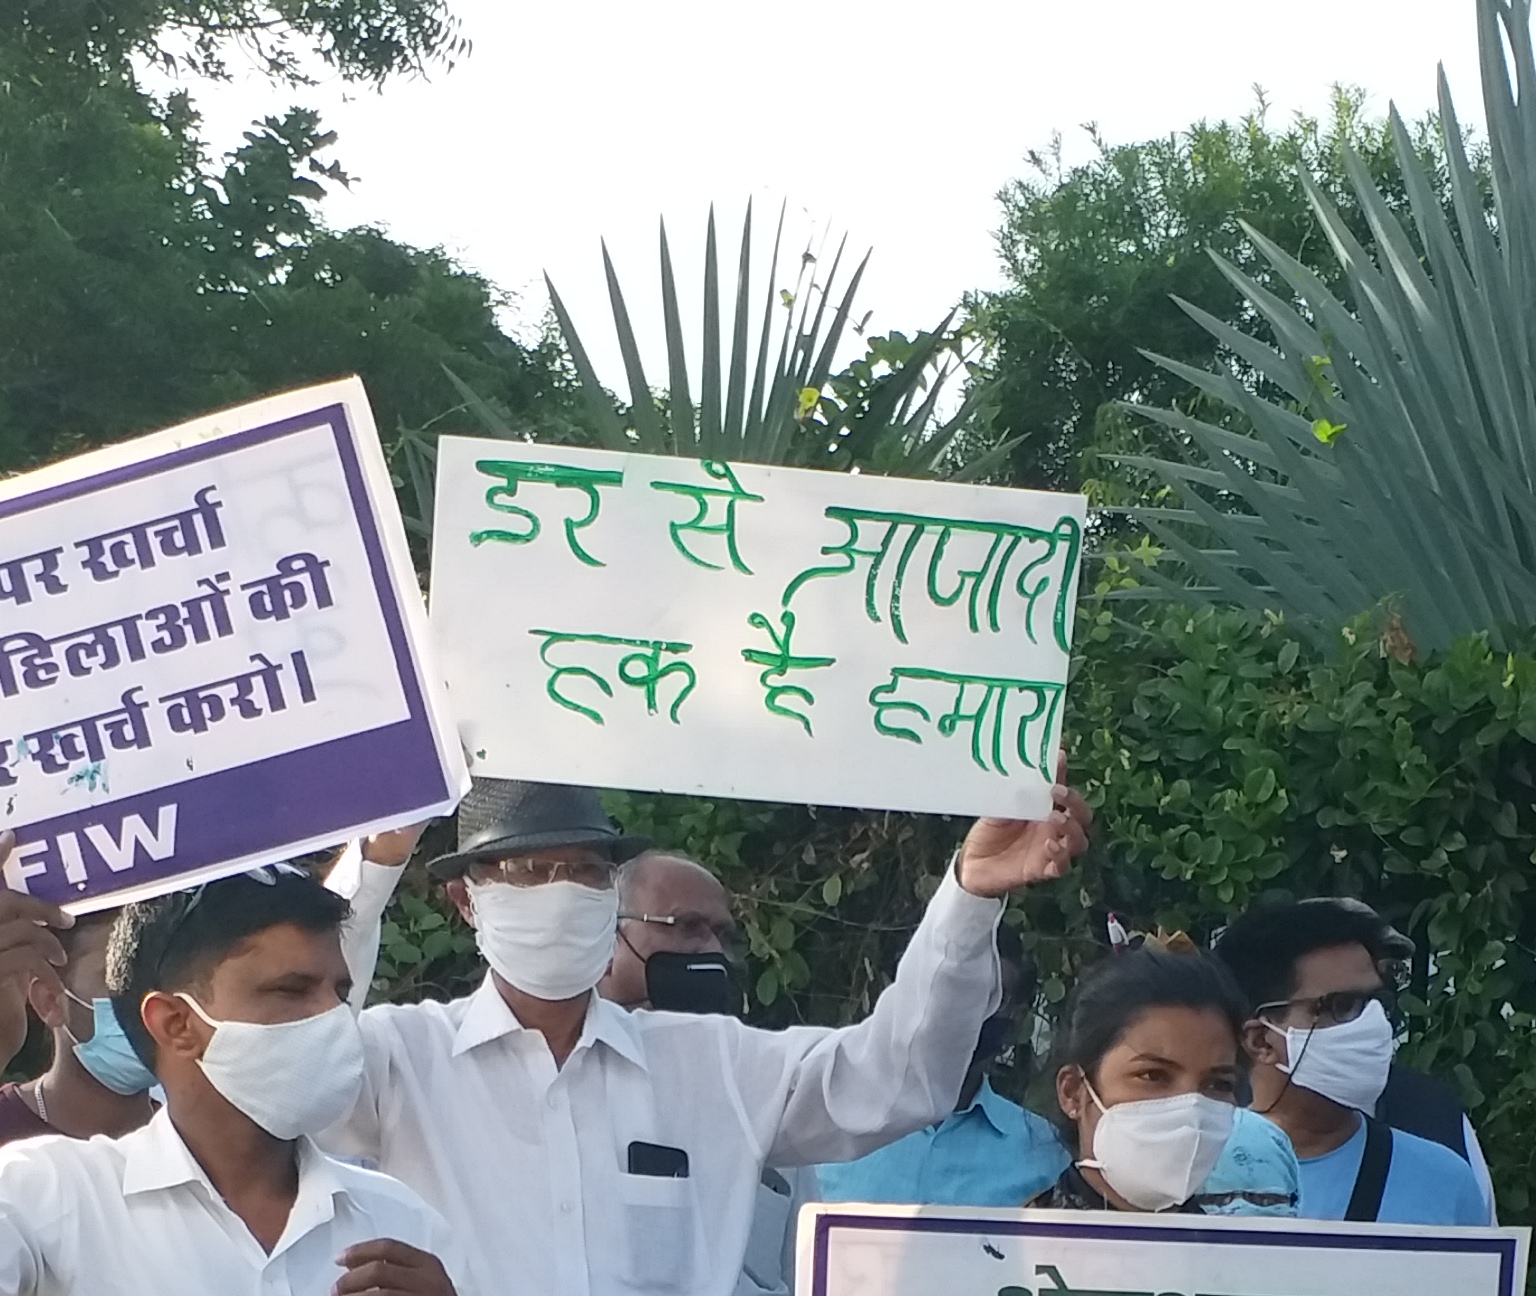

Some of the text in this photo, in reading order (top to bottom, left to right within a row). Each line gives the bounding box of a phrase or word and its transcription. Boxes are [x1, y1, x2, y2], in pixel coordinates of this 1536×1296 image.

[74, 484, 226, 584] खर्चा
[240, 552, 333, 625] की
[469, 459, 1080, 652] डर से आजादी
[20, 685, 152, 776] खर्च
[164, 650, 317, 735] करो।
[529, 609, 1064, 782] हक है हमारा
